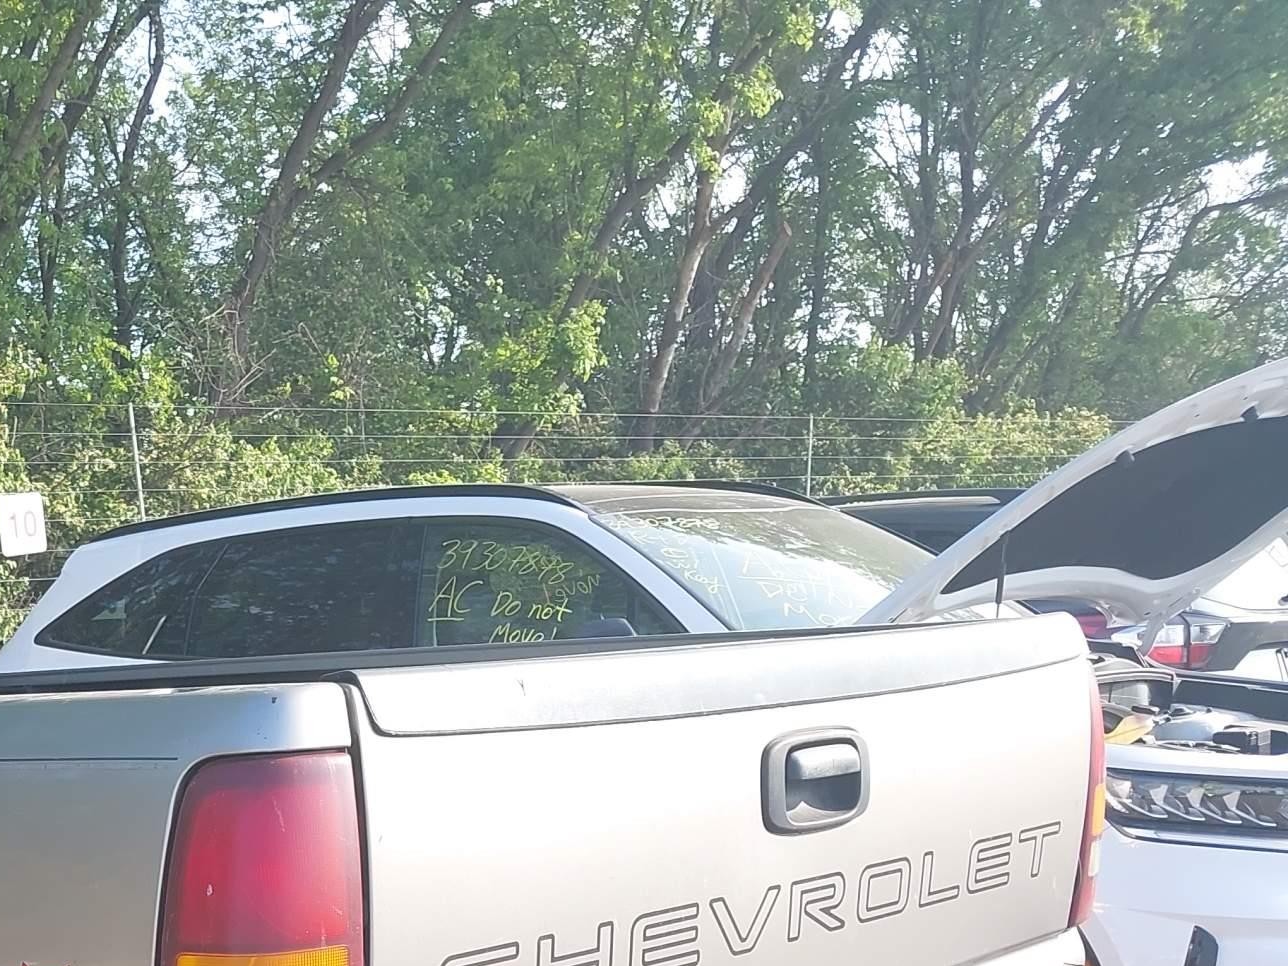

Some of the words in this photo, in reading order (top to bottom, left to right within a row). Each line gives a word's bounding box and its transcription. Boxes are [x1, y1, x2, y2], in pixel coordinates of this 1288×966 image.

[9, 510, 38, 538] 10
[428, 576, 484, 619] AC
[490, 591, 522, 617] Do
[527, 598, 574, 622] not
